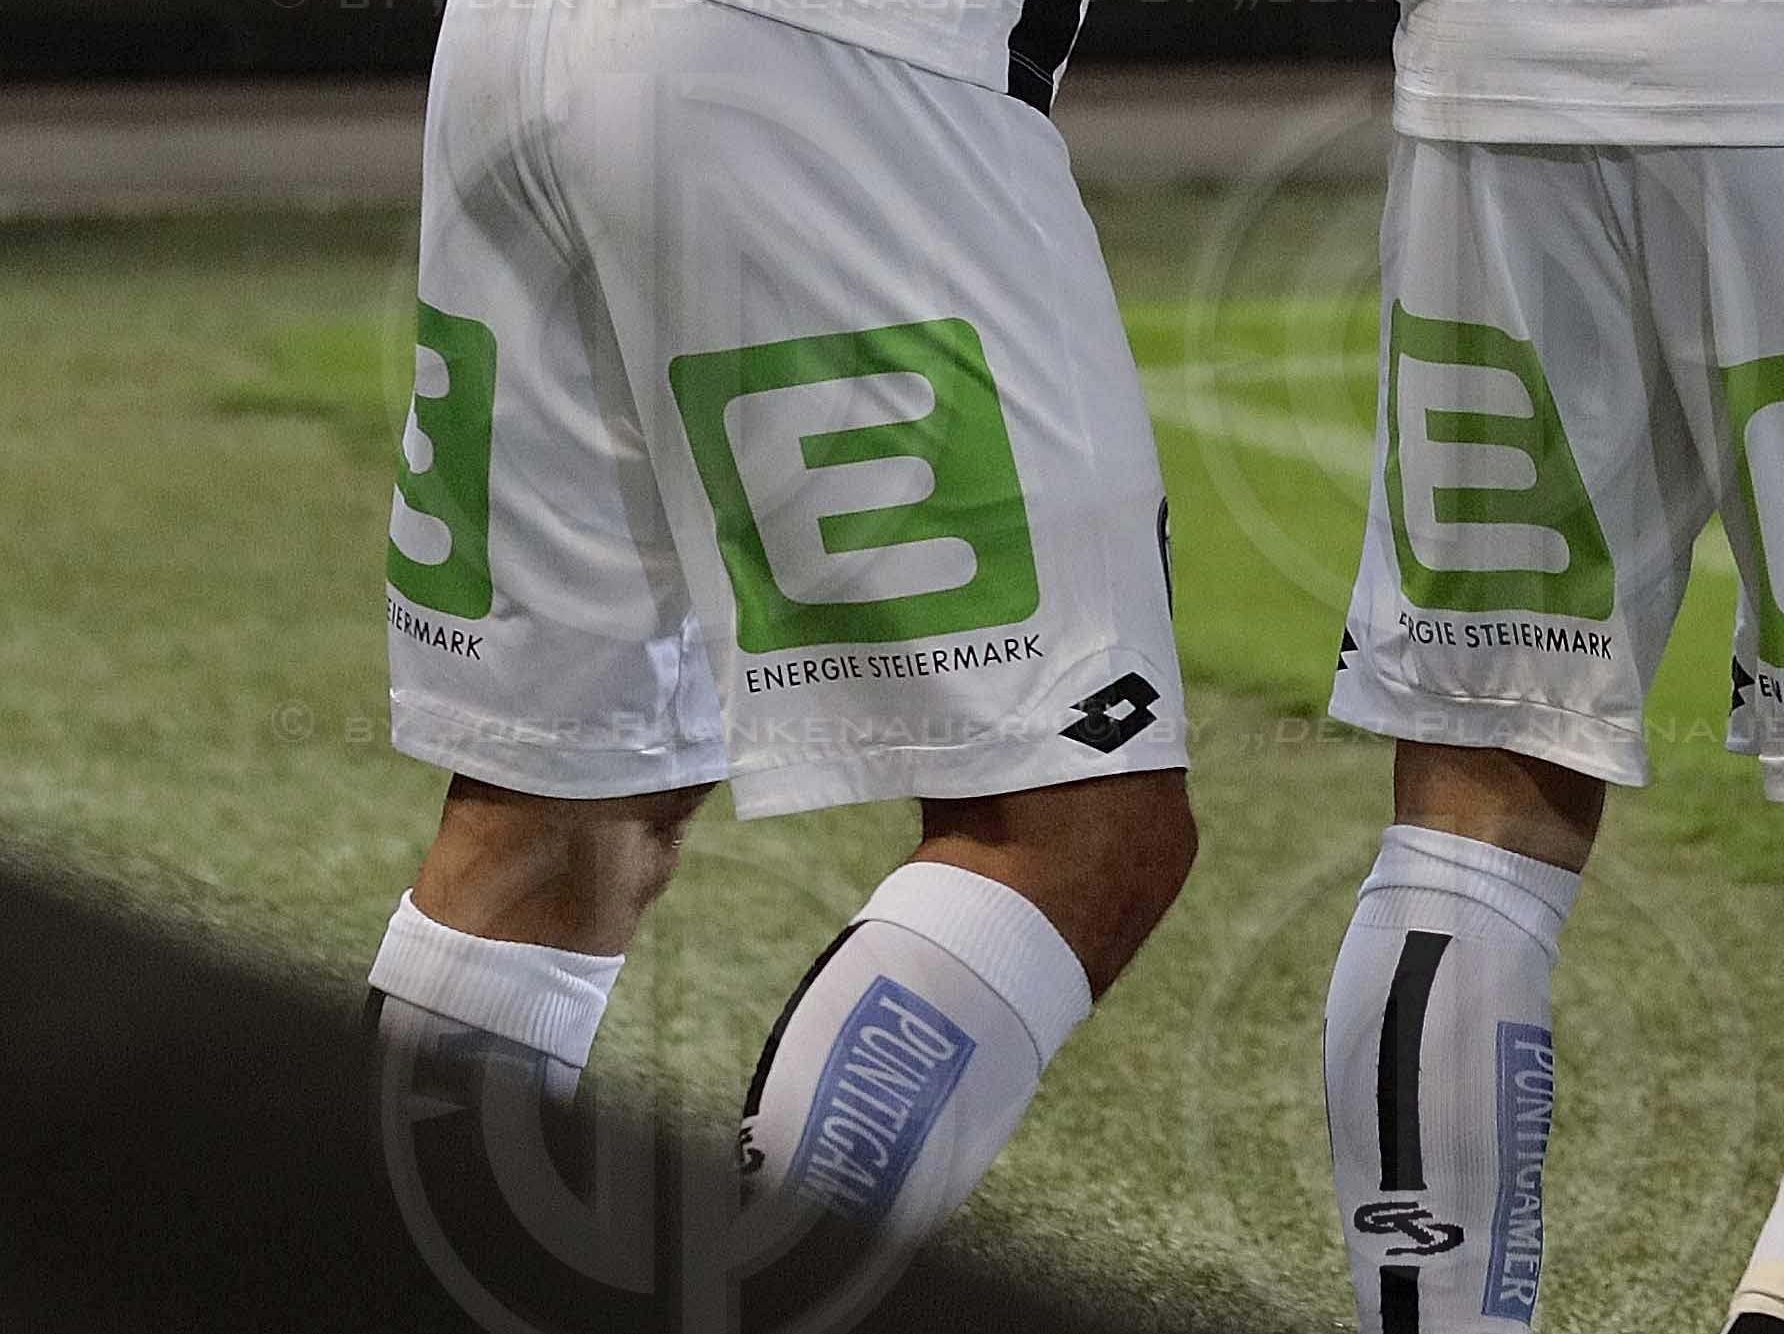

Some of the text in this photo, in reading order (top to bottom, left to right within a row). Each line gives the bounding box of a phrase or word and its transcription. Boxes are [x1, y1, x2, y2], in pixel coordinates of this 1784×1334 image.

[746, 633, 1043, 694] ENERGIE STEIERMARK
[1464, 623, 1613, 661] STEIERMARK
[1481, 1033, 1554, 1305] PUNTIGAMER
